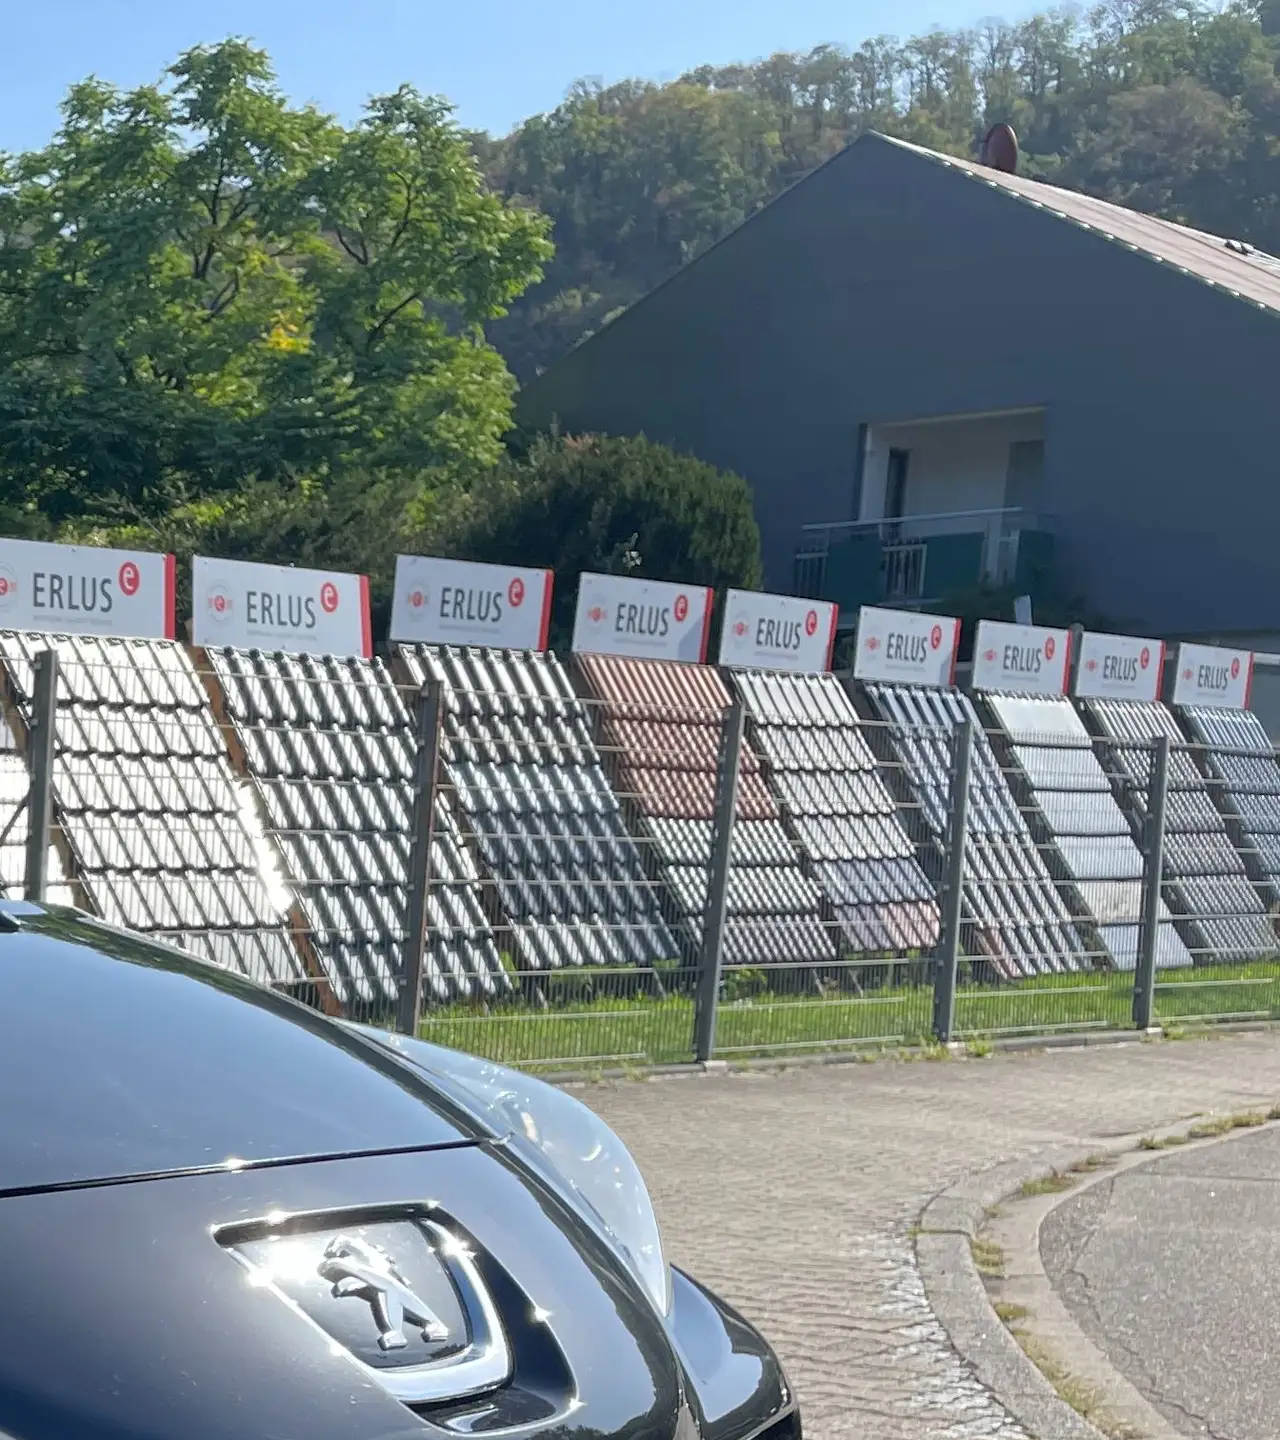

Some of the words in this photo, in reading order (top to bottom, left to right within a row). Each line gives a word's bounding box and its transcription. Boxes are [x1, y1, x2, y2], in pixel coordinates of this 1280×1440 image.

[33, 572, 113, 613] ERLUS
[440, 586, 503, 622] ERLUS
[246, 590, 317, 629] ERLUS
[615, 603, 670, 637] ERLUS
[755, 617, 802, 650] ERLUS
[886, 632, 928, 663] ERLUS
[1002, 645, 1042, 673] ERLUS
[1102, 655, 1138, 681] ERLUS
[1197, 664, 1229, 690] ERLUS
